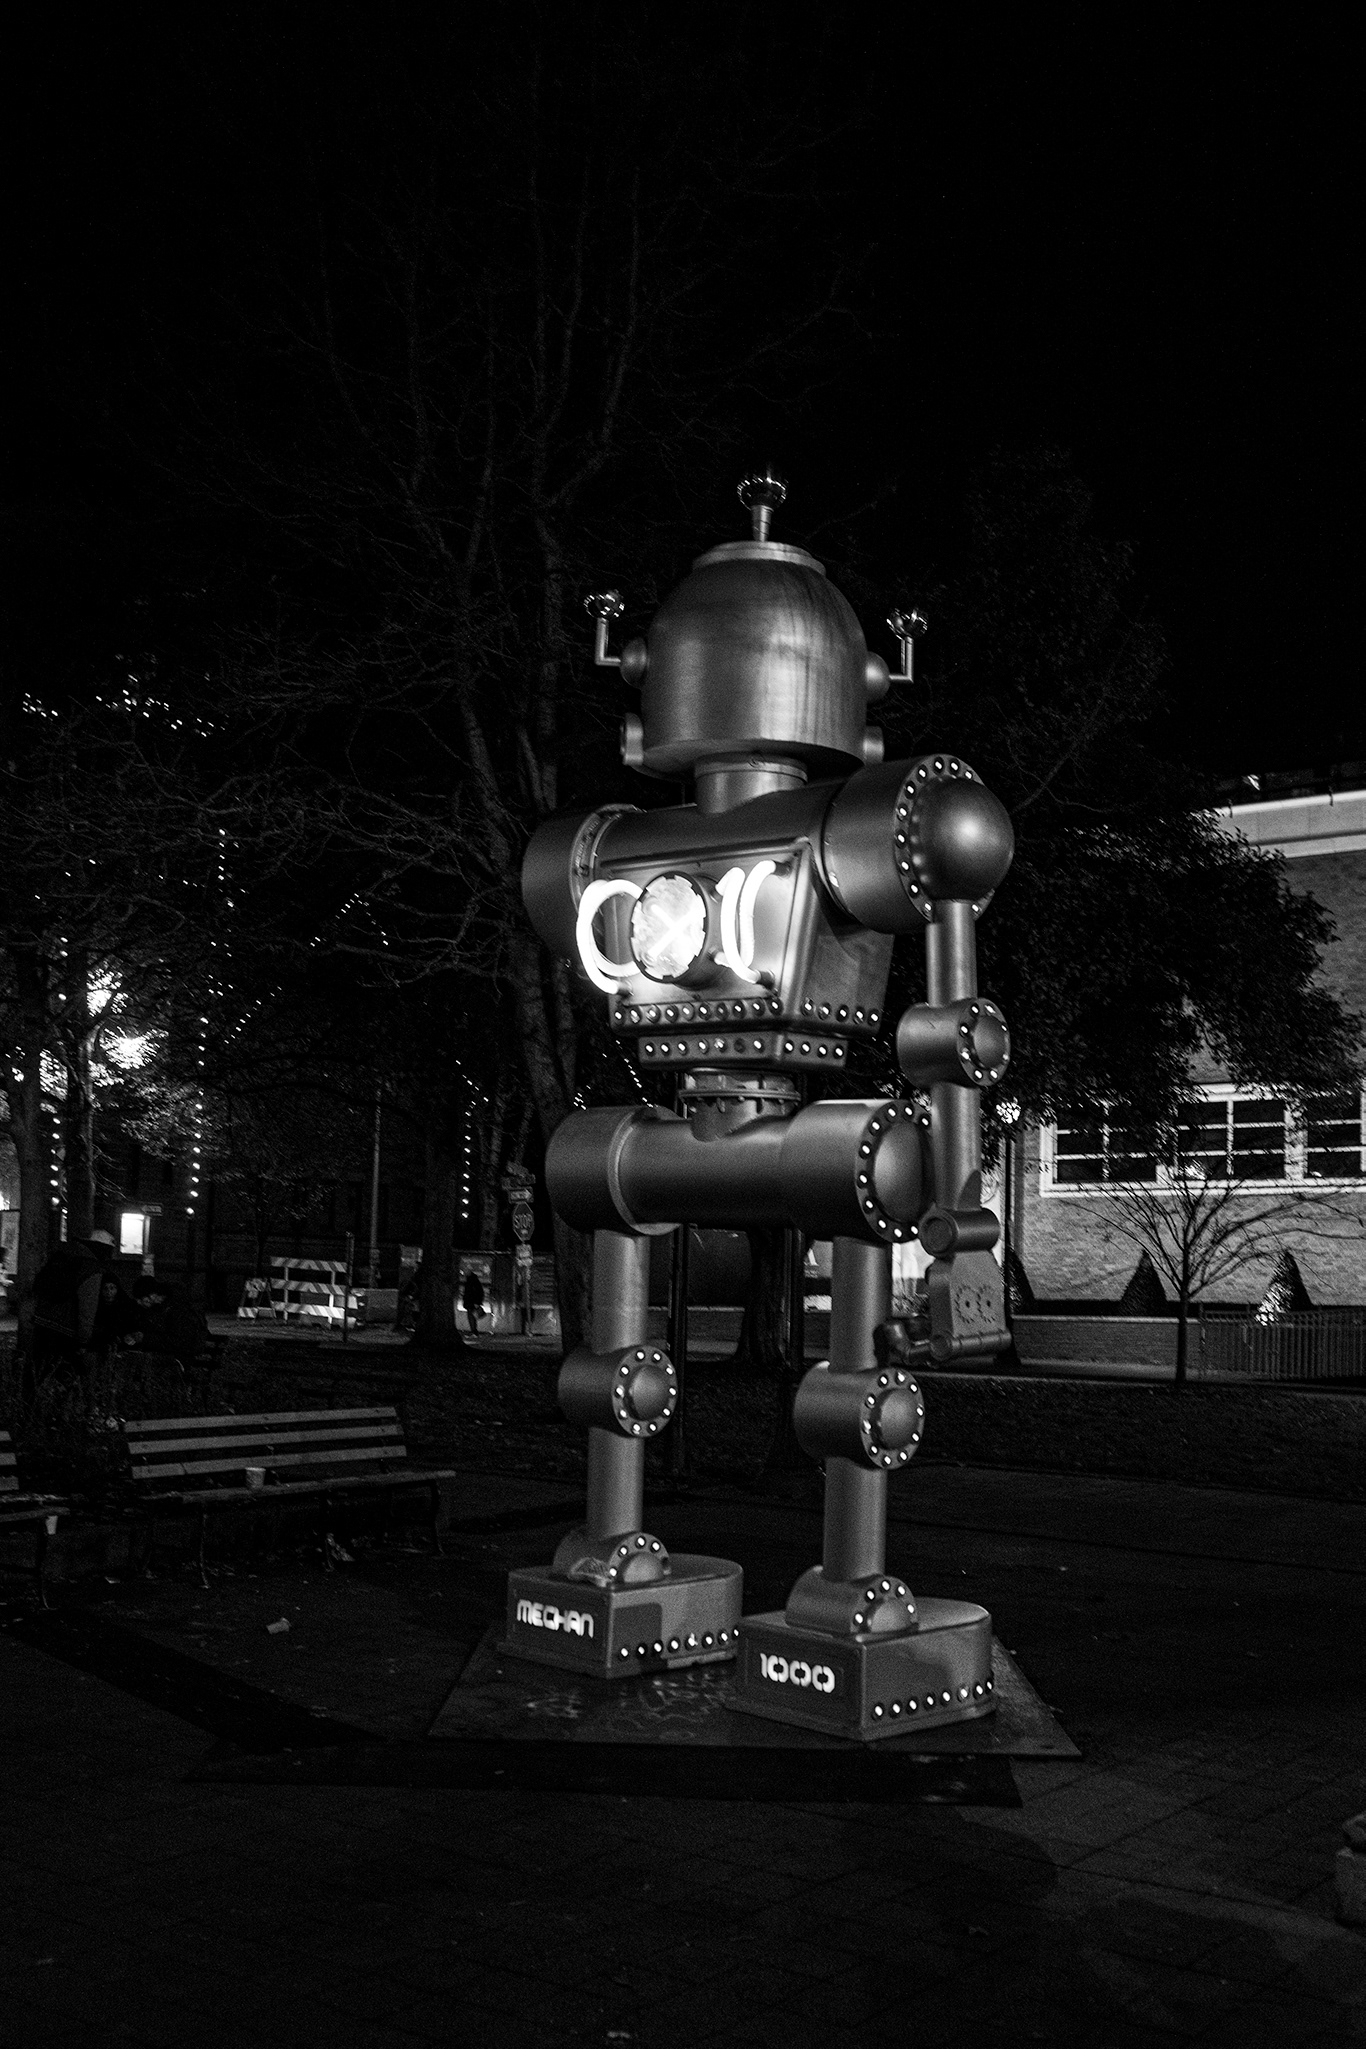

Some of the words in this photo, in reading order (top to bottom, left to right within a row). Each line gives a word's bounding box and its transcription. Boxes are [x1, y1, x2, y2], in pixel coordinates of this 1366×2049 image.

[513, 1212, 532, 1229] STOP
[517, 1599, 594, 1638] MECHAN
[760, 1653, 835, 1693] 1000
